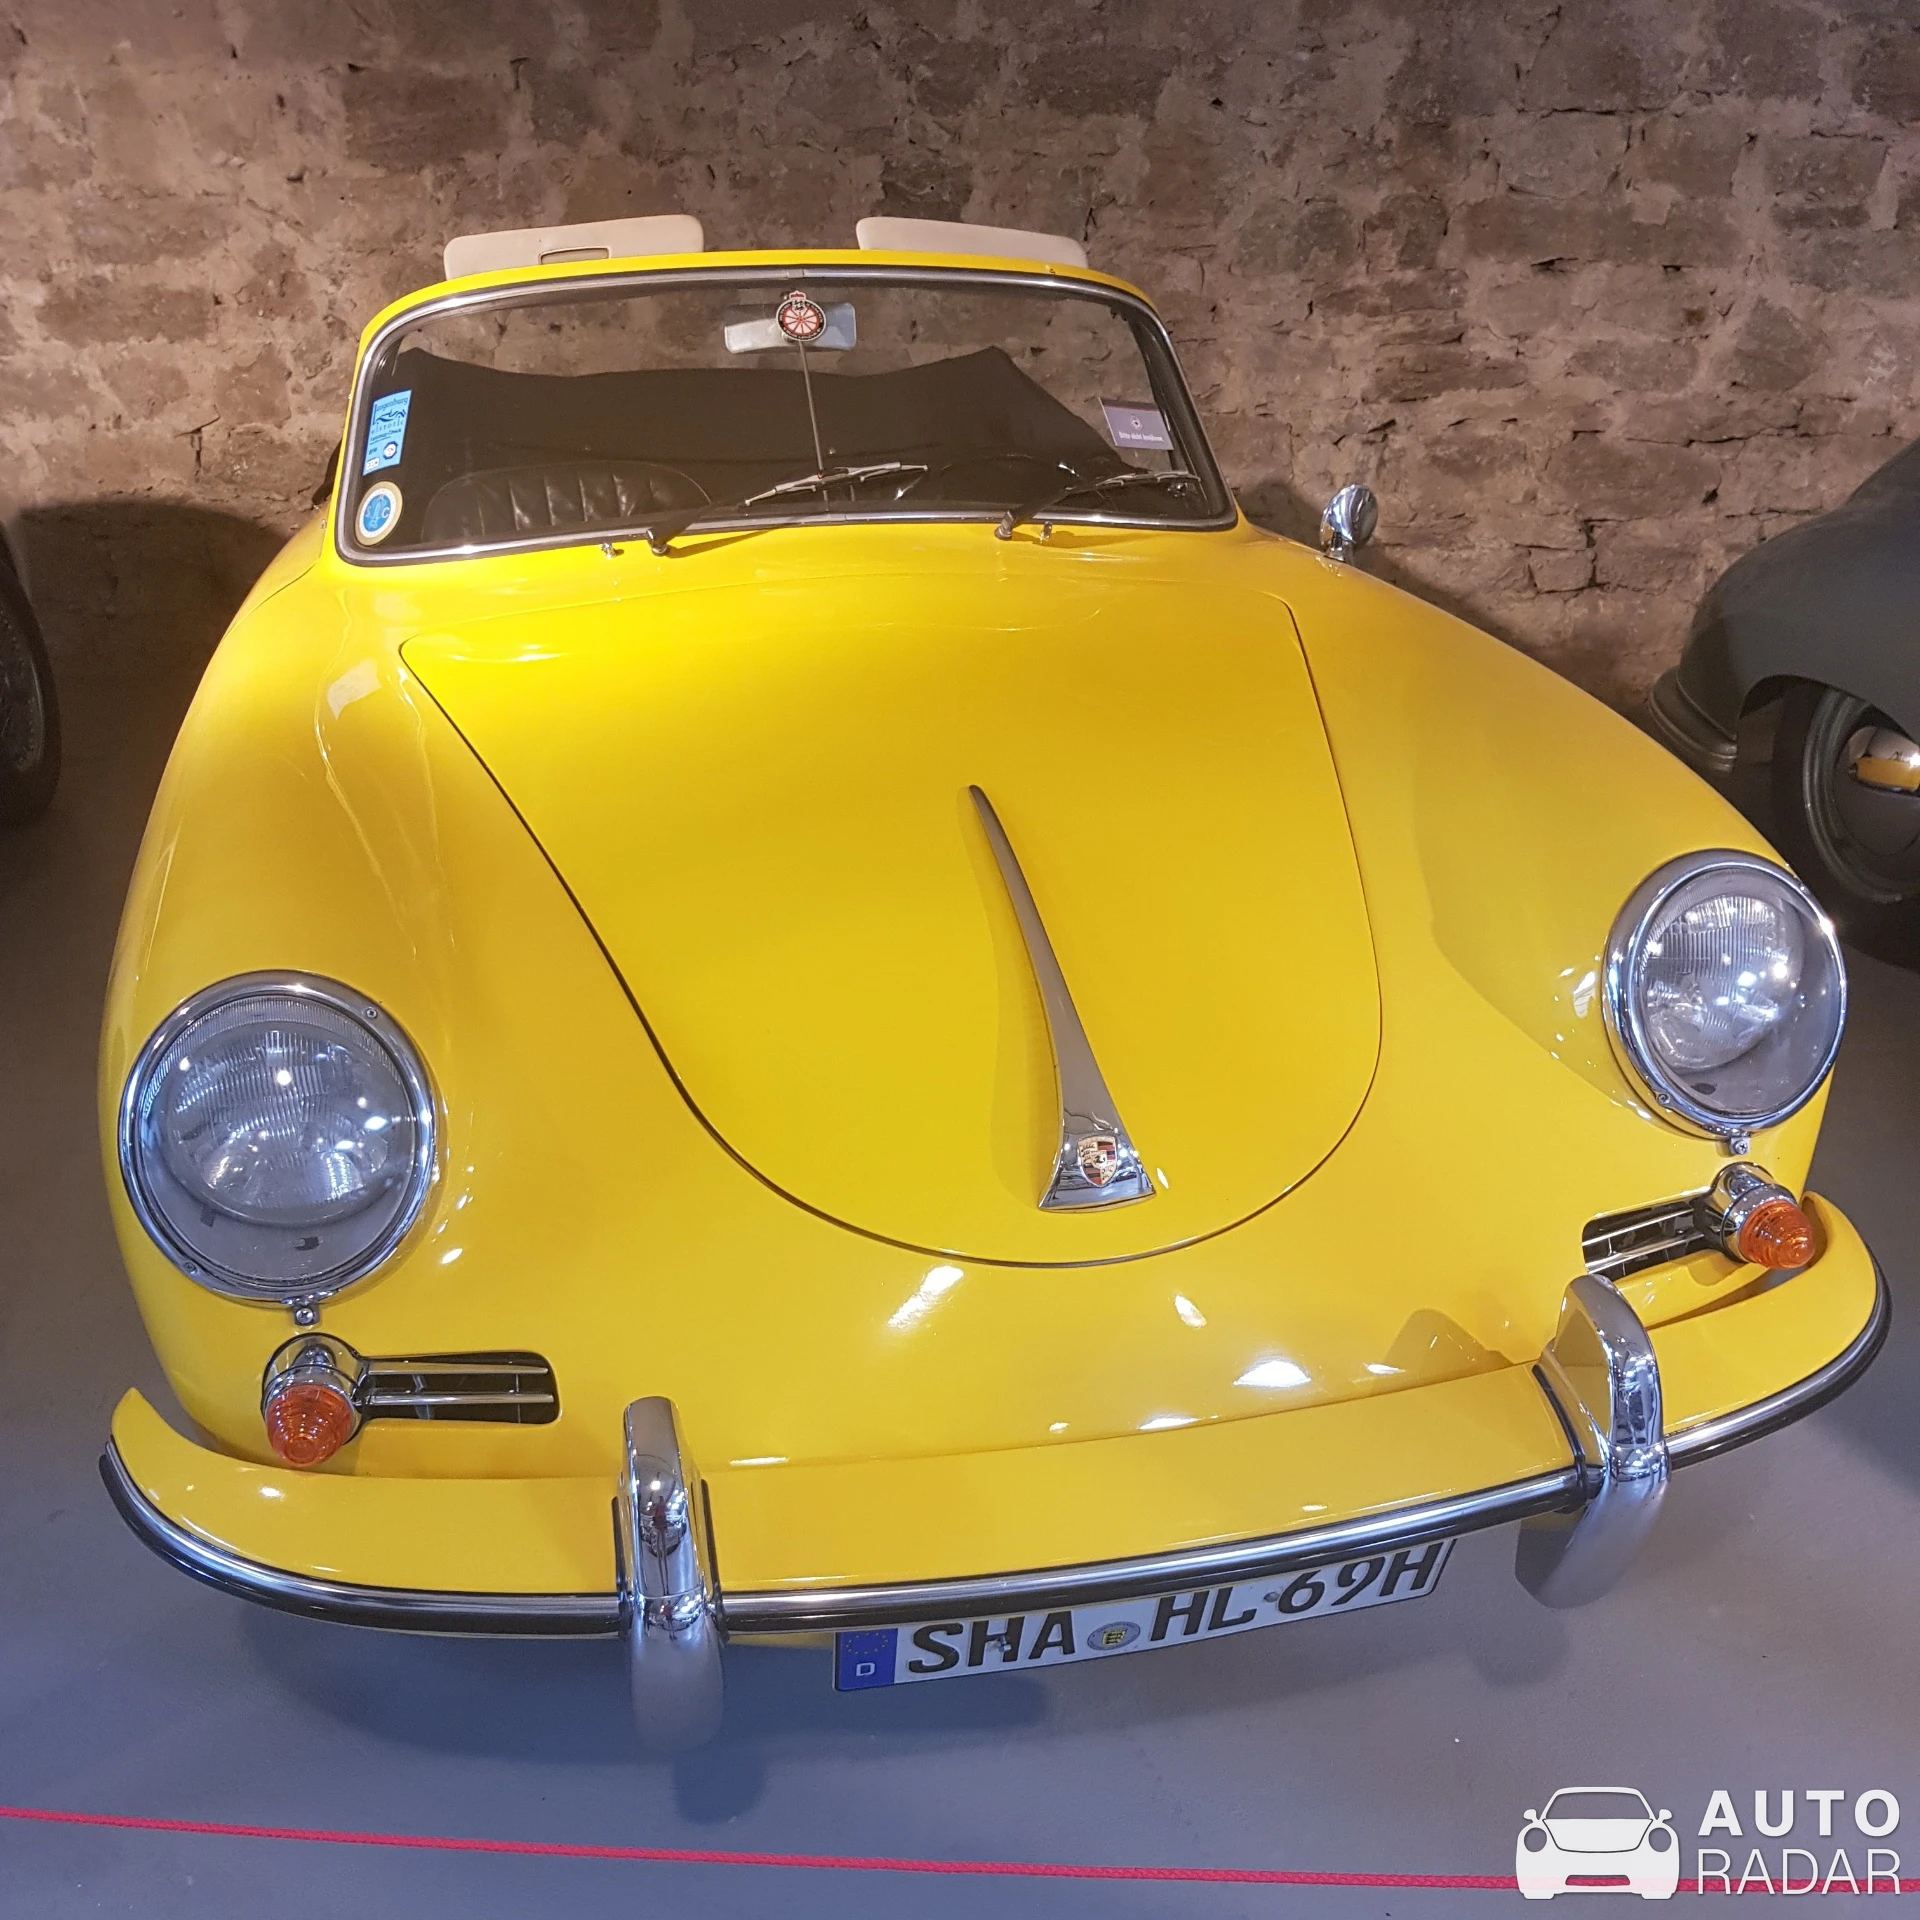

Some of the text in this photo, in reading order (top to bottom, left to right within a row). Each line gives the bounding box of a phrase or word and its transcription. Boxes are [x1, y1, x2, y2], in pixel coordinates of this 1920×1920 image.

[909, 1611, 1075, 1673] SHA
[1150, 1587, 1257, 1641] HL
[1278, 1542, 1444, 1613] 69H
[856, 1663, 875, 1677] D
